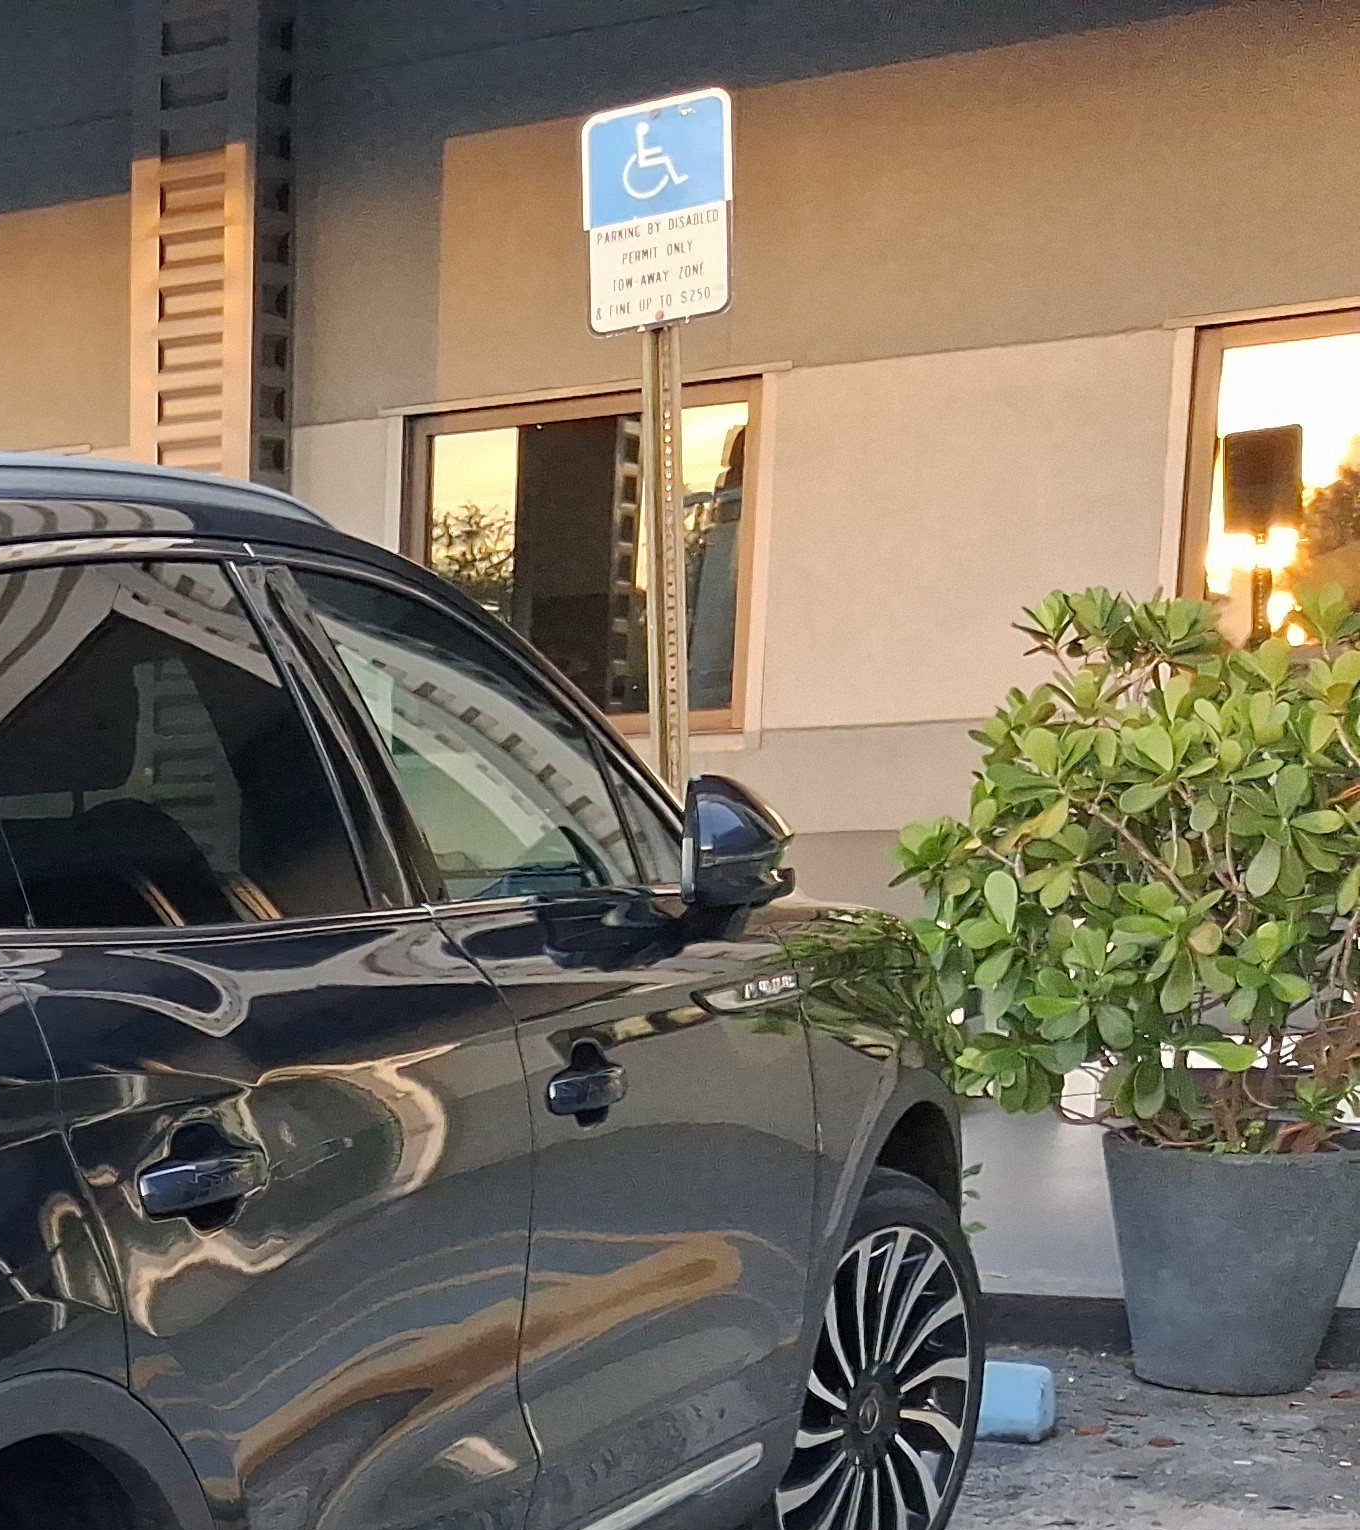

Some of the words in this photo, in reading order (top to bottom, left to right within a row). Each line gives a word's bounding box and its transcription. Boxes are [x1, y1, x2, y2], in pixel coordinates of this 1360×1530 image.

[597, 225, 640, 245] PARKING
[647, 222, 660, 235] BY
[668, 209, 719, 231] DISABLED
[622, 247, 657, 264] PERMIT
[667, 240, 693, 256] ONLY
[679, 262, 704, 279] ZONE
[596, 307, 602, 320] &
[609, 301, 631, 318] FINE
[639, 298, 652, 312] UP
[660, 293, 672, 308] TO
[680, 286, 711, 303] $250
